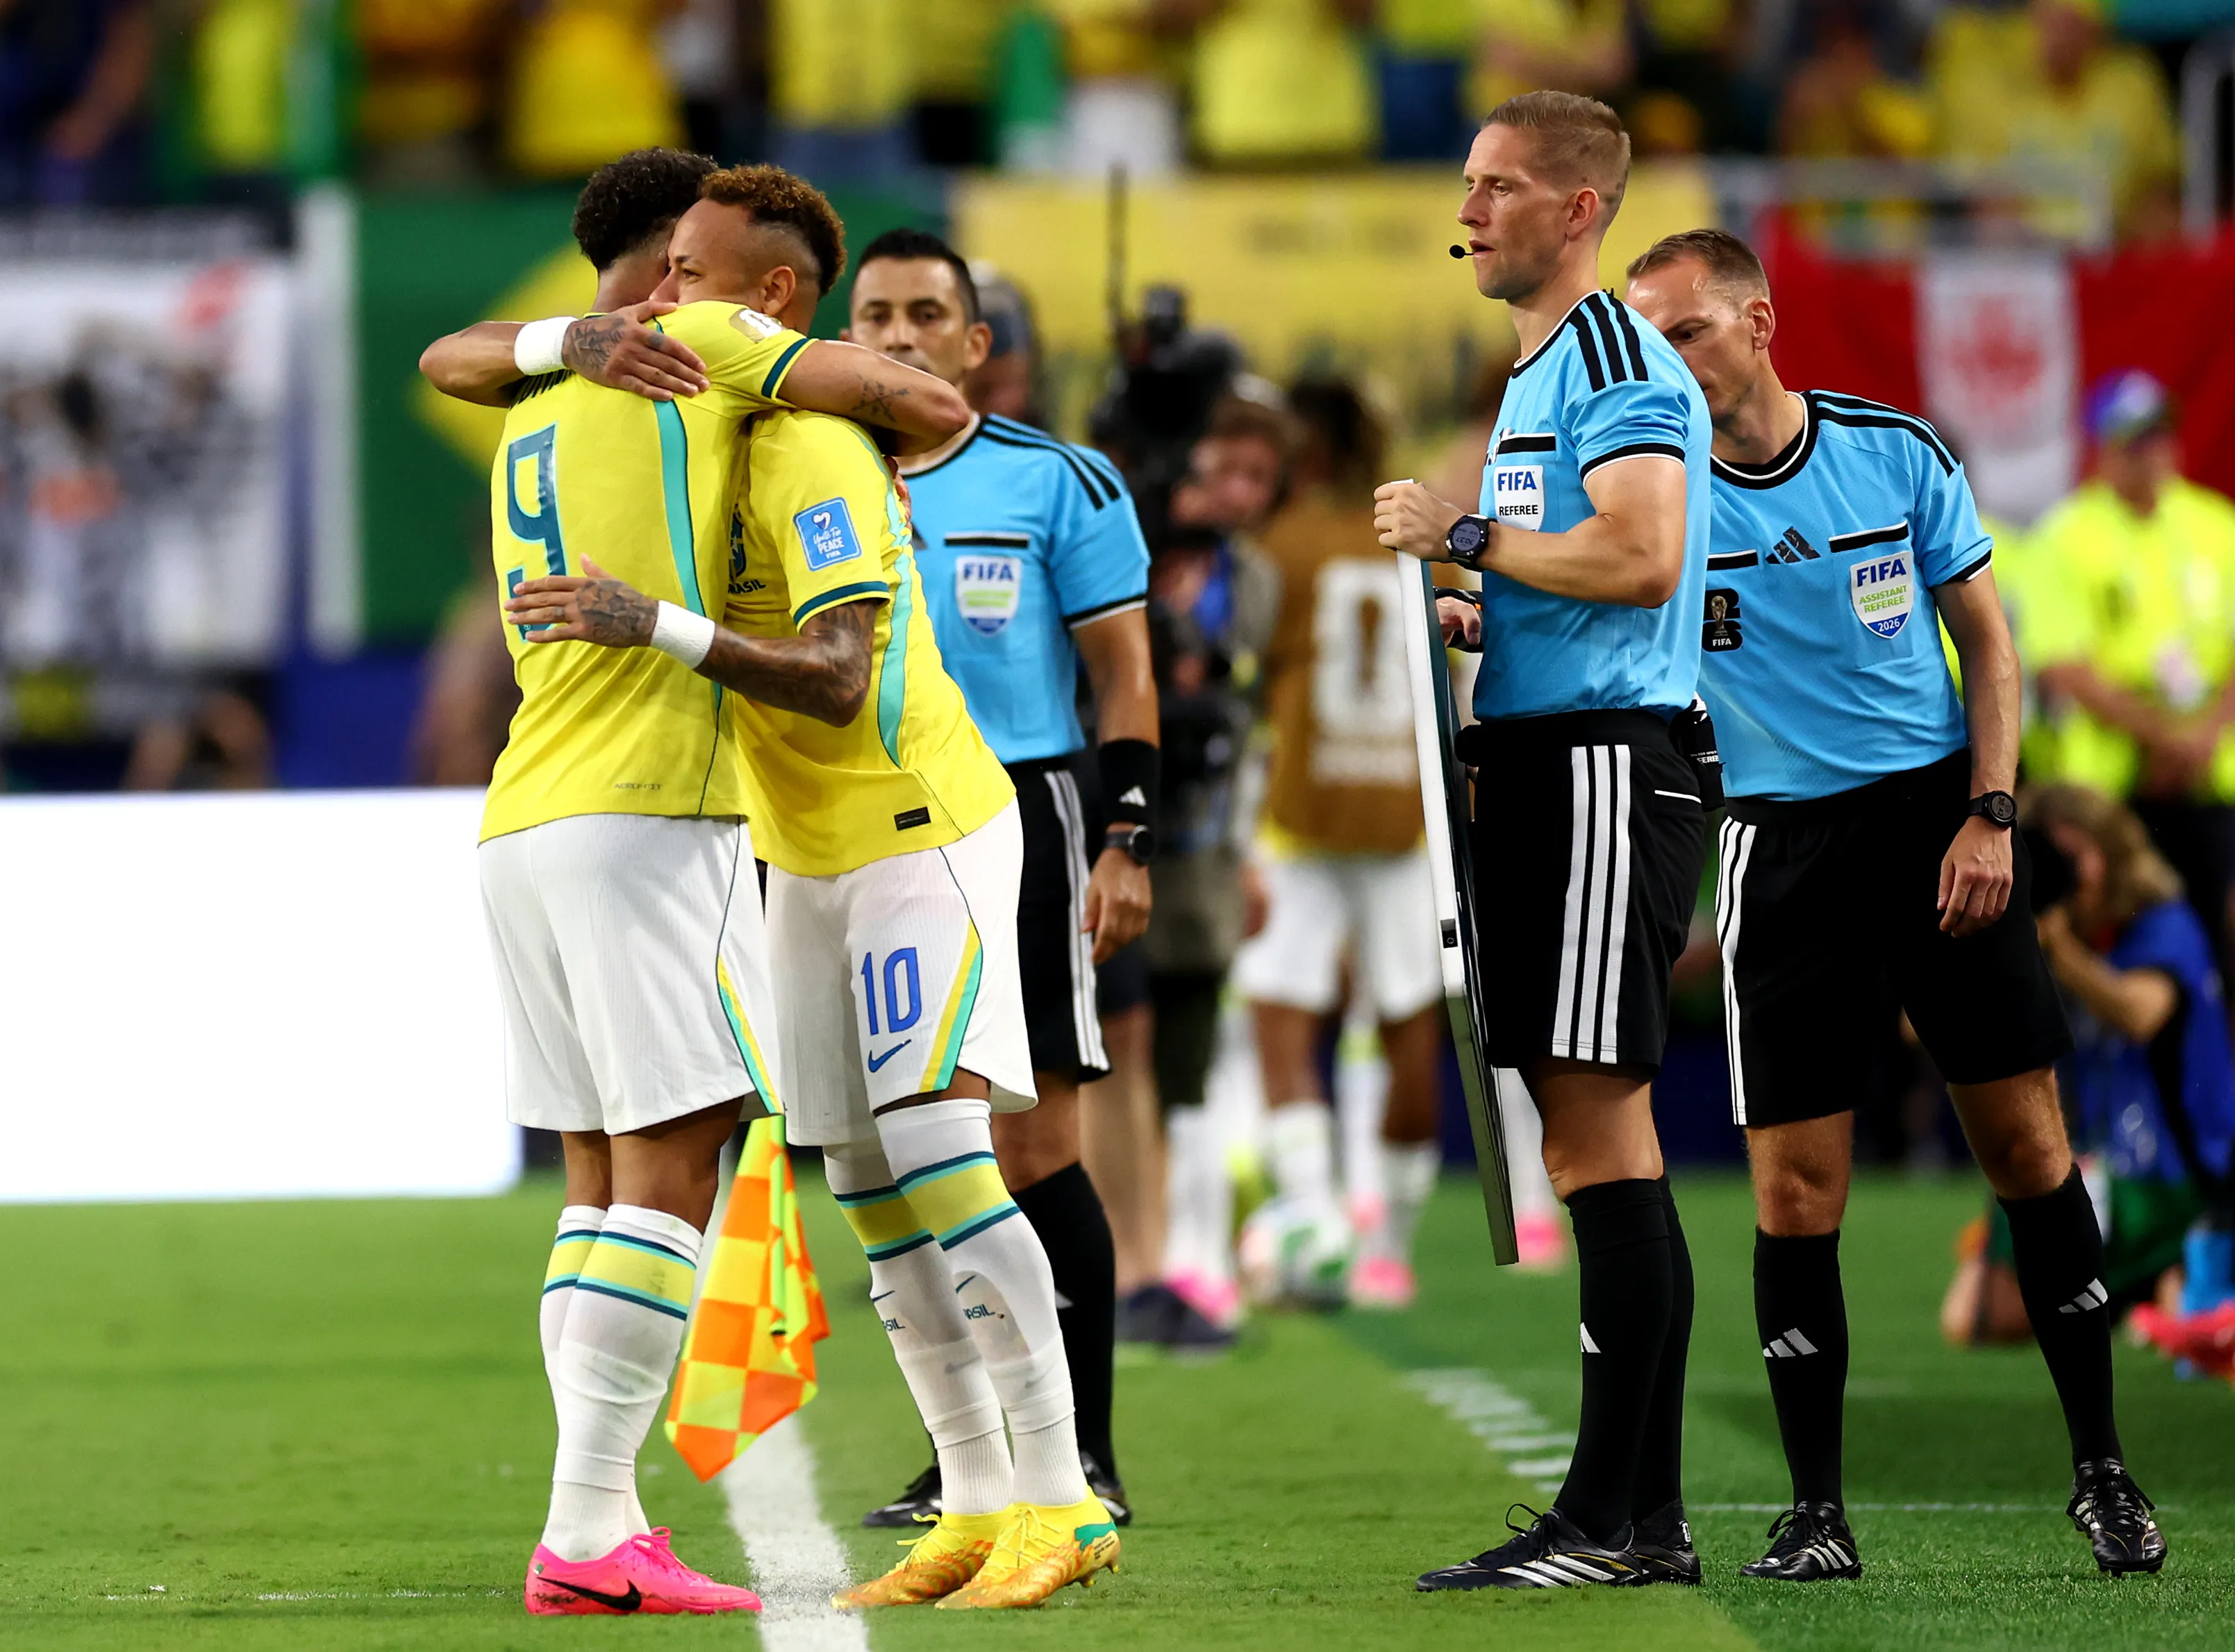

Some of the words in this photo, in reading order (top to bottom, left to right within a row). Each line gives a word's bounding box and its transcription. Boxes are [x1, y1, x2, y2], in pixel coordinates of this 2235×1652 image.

[1497, 471, 1537, 491] FIFA
[1499, 504, 1538, 516] REFEREE
[506, 420, 569, 643] 9
[817, 536, 845, 554] PEACE
[963, 562, 1014, 580] FIFA
[1856, 558, 1906, 587] FIFA
[728, 579, 766, 594] RASIL
[1859, 585, 1907, 605] ASSISTANT
[1864, 595, 1906, 613] REFEREE
[1878, 618, 1900, 632] 2026
[1712, 637, 1732, 646] FIFA
[1696, 755, 1719, 764] FEREE
[861, 946, 922, 1035] 10
[963, 1303, 995, 1319] ASIL
[881, 1317, 906, 1331] SIL
